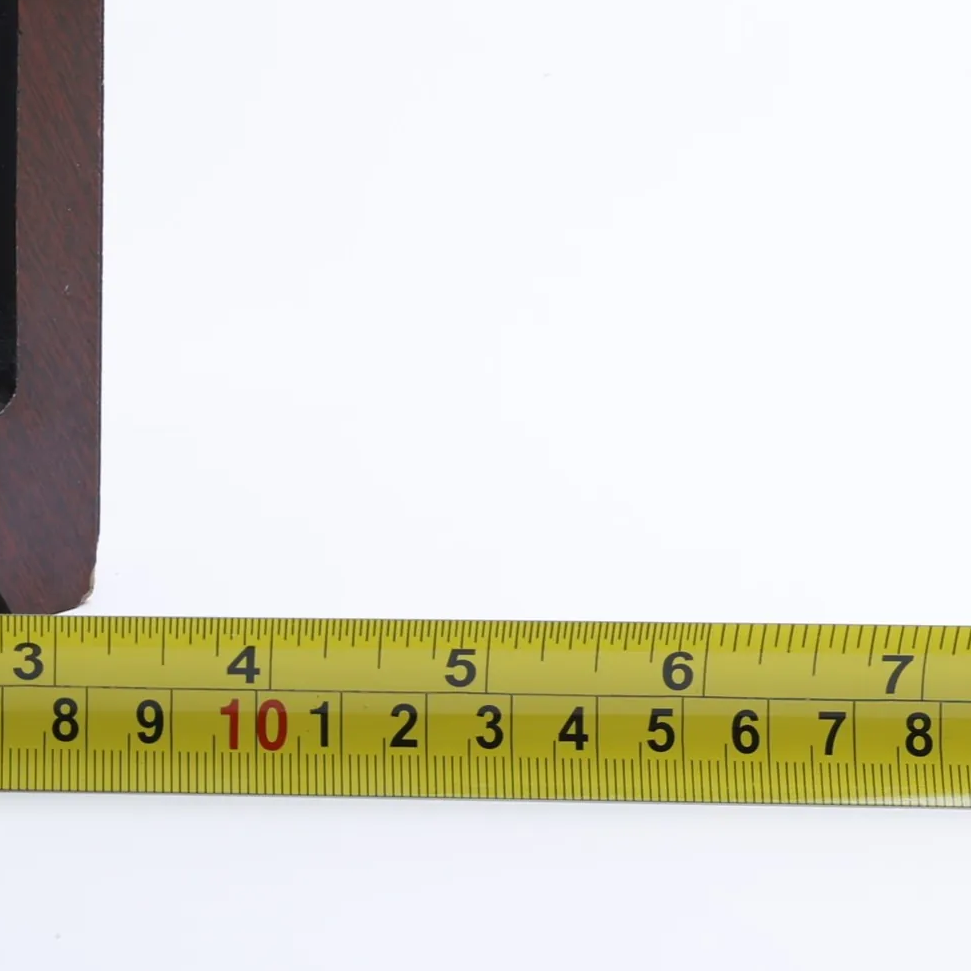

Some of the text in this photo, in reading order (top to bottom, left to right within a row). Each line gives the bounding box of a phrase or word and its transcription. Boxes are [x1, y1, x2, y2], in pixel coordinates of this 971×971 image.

[13, 642, 44, 681] 3
[227, 647, 260, 684] 4
[445, 649, 477, 687] 5
[661, 652, 694, 691] 6
[881, 655, 915, 694] 7
[51, 698, 80, 741] 8
[136, 699, 165, 743] 9
[219, 699, 288, 751] 10
[309, 702, 331, 747] 1
[390, 704, 419, 747] 2
[475, 705, 504, 749] 3
[558, 707, 589, 750] 4
[646, 708, 675, 752] 5
[730, 709, 760, 754] 6
[817, 711, 847, 755] 7
[905, 712, 933, 757] 8
